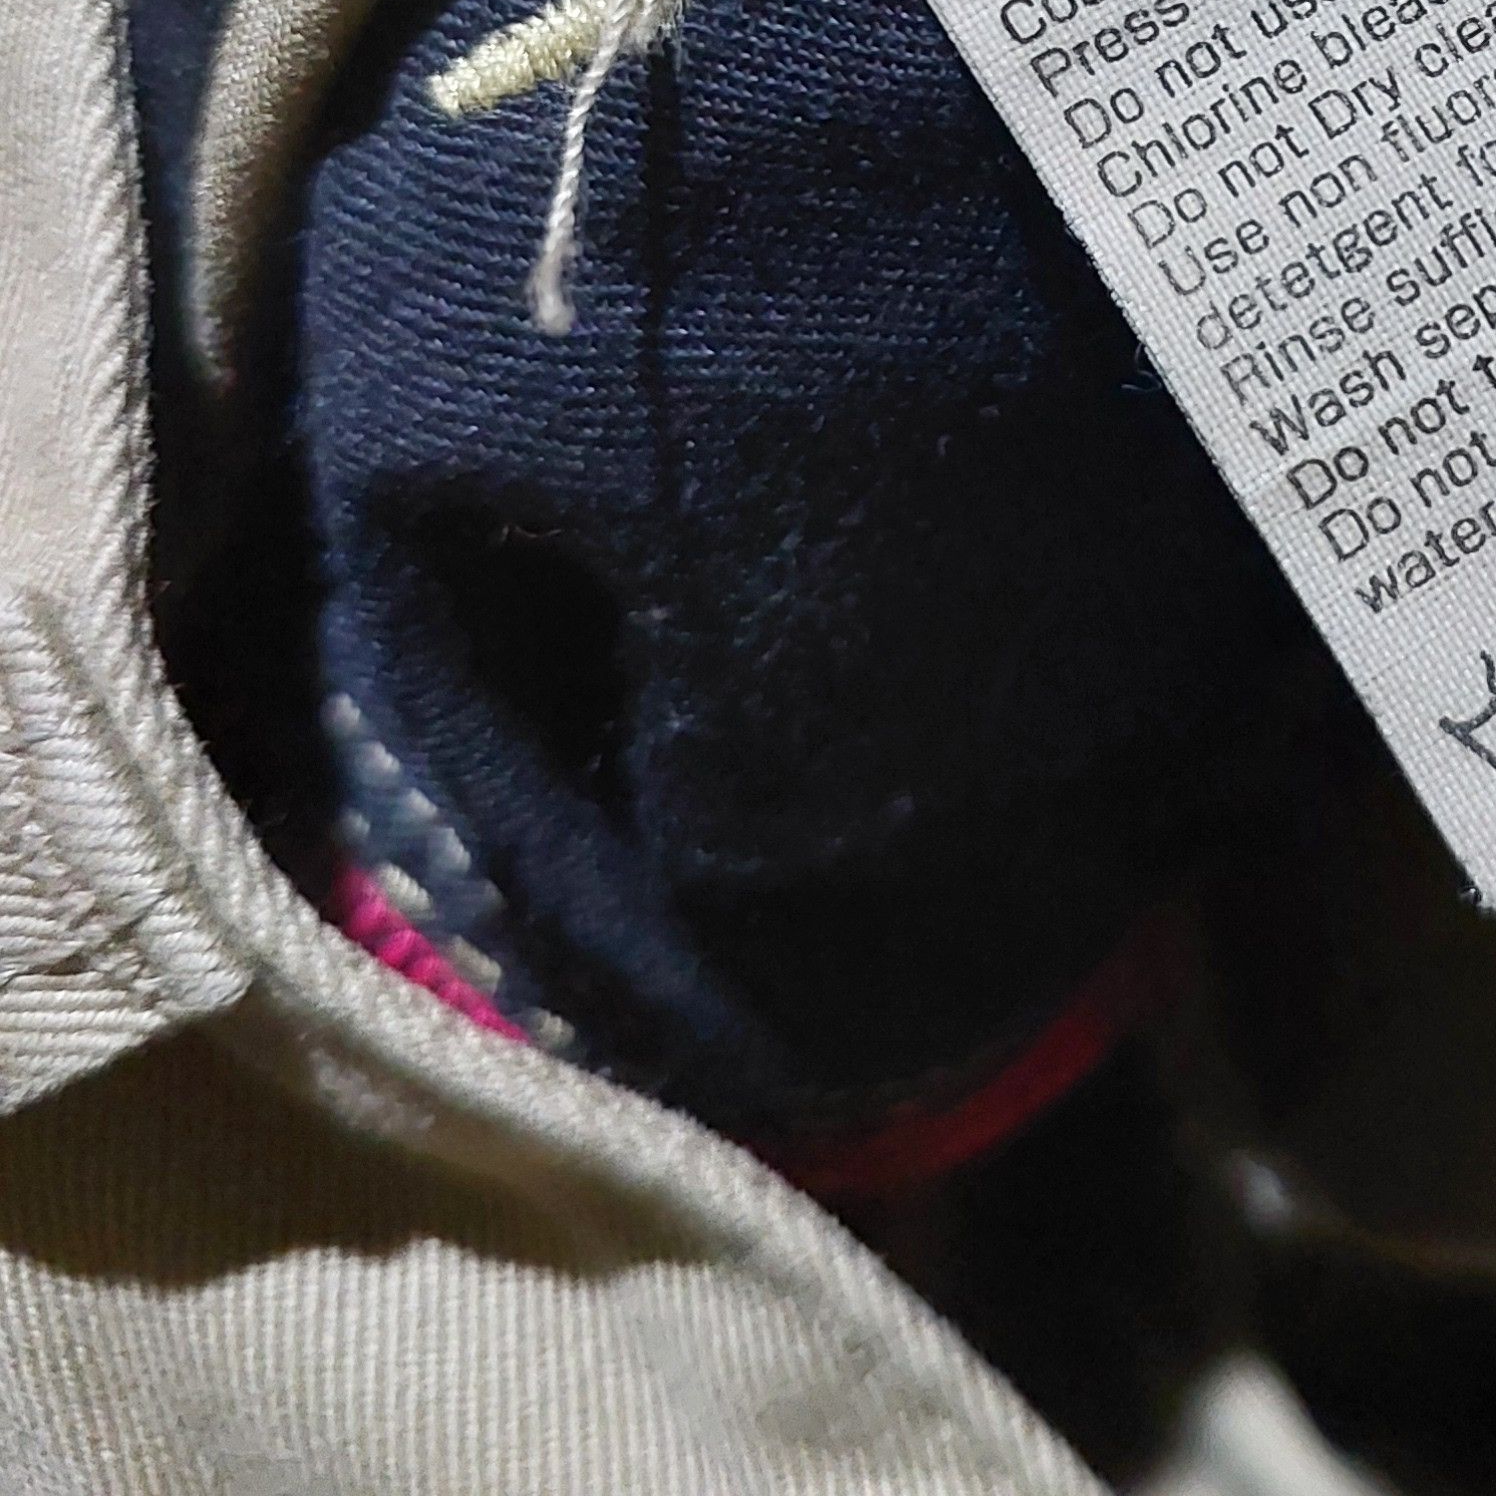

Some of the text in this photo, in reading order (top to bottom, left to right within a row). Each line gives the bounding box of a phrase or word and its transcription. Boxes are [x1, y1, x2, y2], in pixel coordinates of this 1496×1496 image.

[1064, 87, 1144, 149] Do
[1155, 23, 1247, 97] not
[1097, 59, 1307, 197] Chlorine
[1128, 188, 1207, 249] Do
[1218, 125, 1310, 197] not
[1308, 66, 1400, 139] Dry
[1158, 218, 1270, 295] Use
[1281, 154, 1377, 227] non
[1220, 297, 1375, 402] Rinse
[1250, 348, 1406, 455] Wash
[1286, 446, 1369, 509] Do
[1378, 380, 1470, 454] not
[1318, 497, 1400, 562] Do
